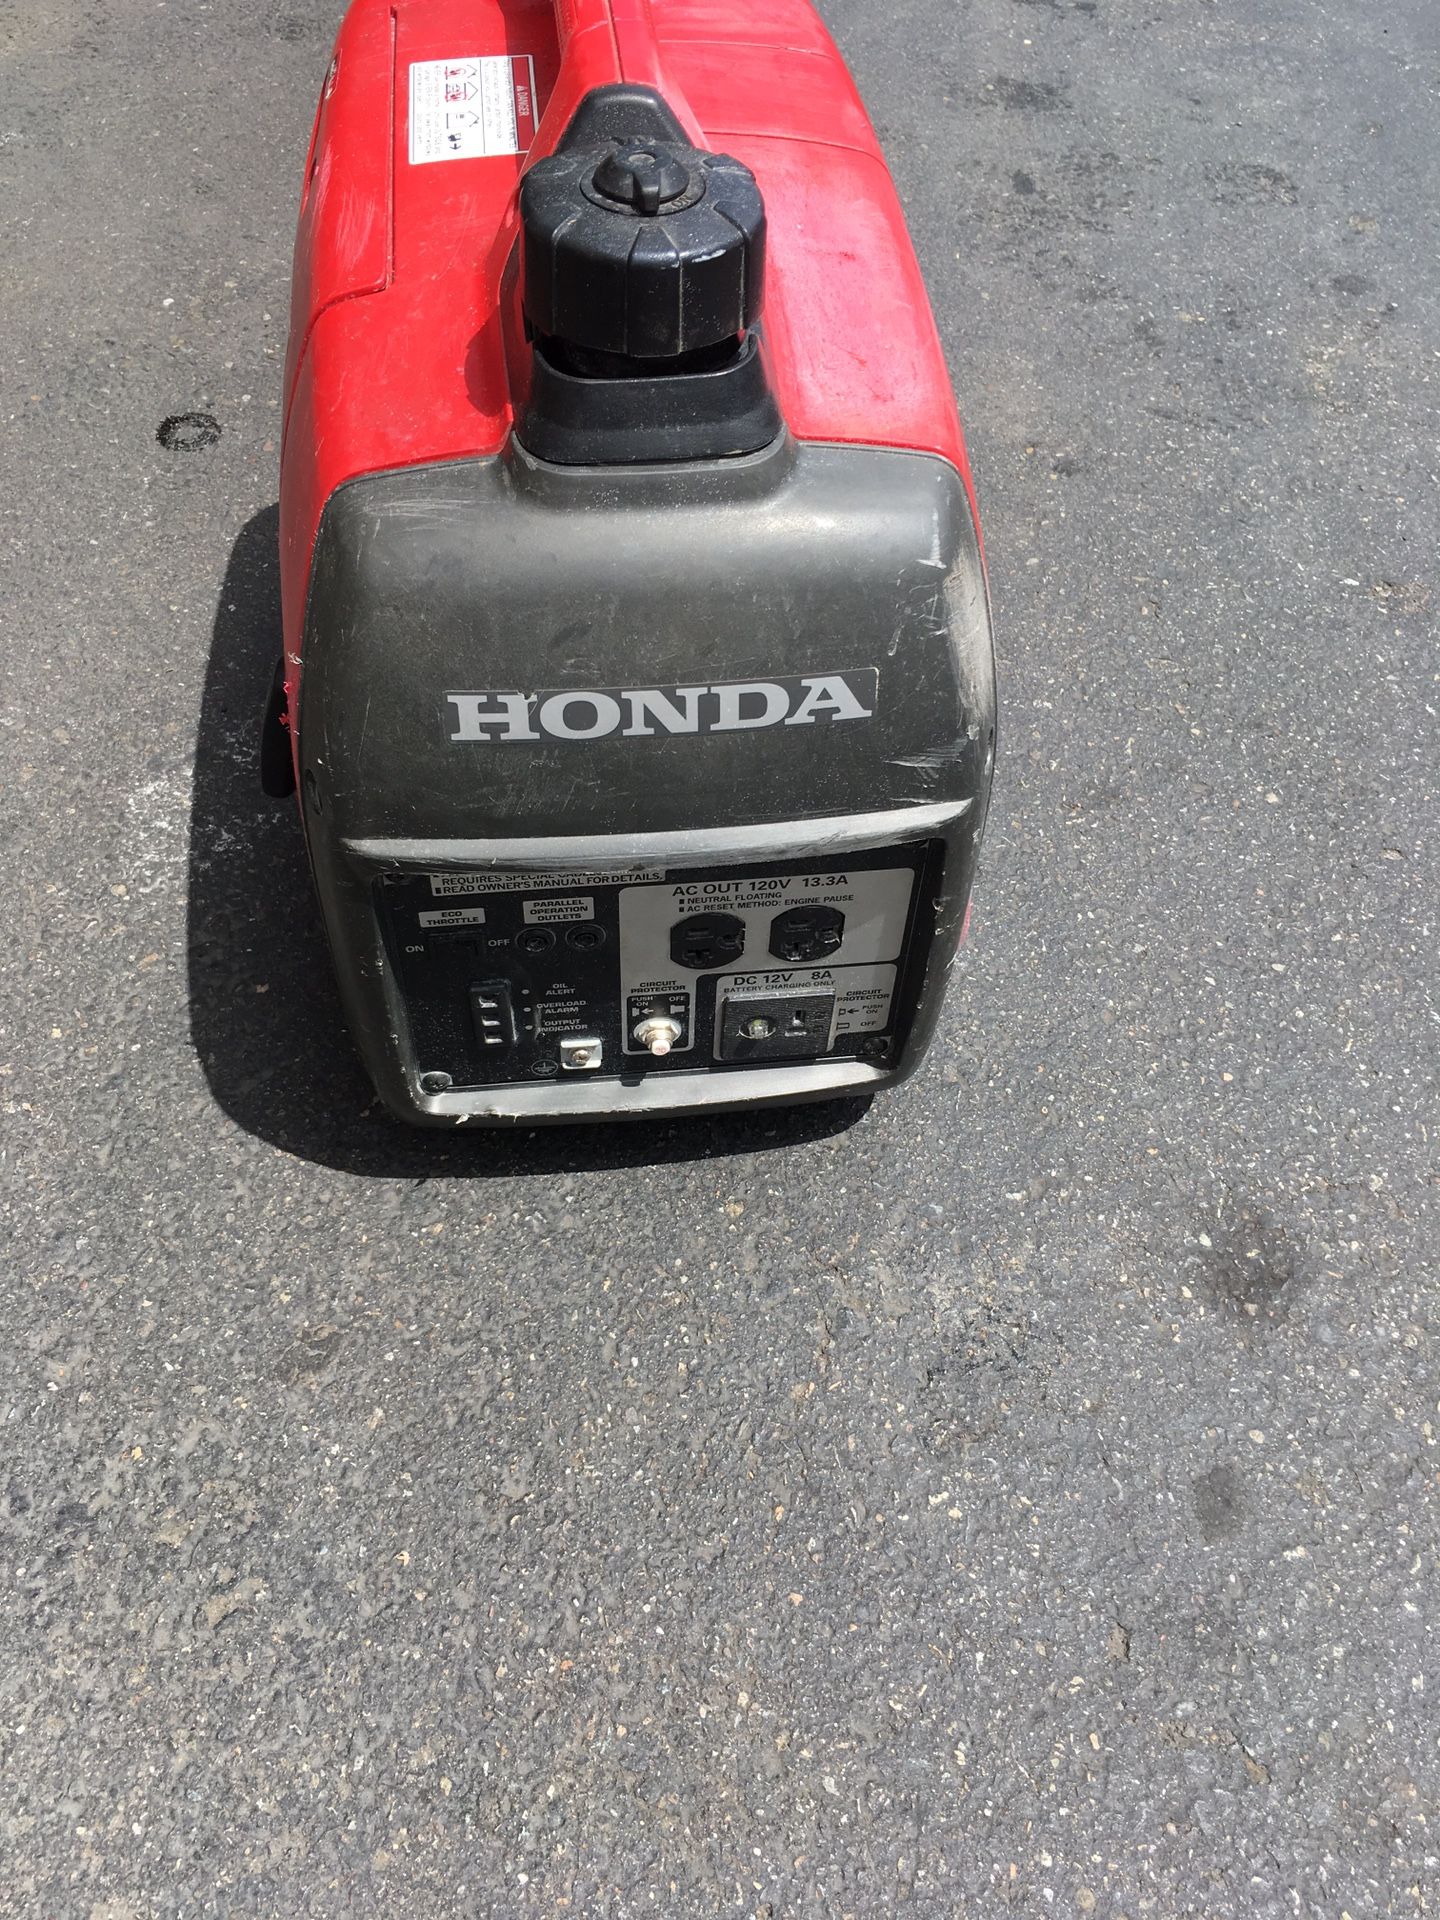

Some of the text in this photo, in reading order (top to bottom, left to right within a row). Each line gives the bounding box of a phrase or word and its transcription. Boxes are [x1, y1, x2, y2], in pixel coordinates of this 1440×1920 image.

[517, 92, 529, 117] DANGER
[447, 676, 872, 740] HONDA
[442, 875, 502, 886] REQUIRES
[443, 886, 474, 894] READ
[477, 881, 531, 891] OWNER'S
[533, 878, 584, 888] MANUAL
[587, 875, 610, 885] FOR
[612, 872, 663, 883] DETAILS.
[672, 875, 848, 896] AC OUT 120V 13.3A
[687, 892, 782, 904] NEUTRAL FLOATING
[703, 903, 734, 911] RESET
[737, 900, 781, 909] METHOD:
[784, 897, 821, 905] ENGINE
[823, 894, 854, 902] PAUSE
[533, 899, 584, 908] PARALLEL
[441, 910, 462, 918] ECO
[529, 906, 588, 915] OPERATION
[426, 917, 479, 926] THROTTLE
[537, 913, 582, 922] OUTLETS
[488, 939, 511, 947] OFF
[405, 945, 424, 953] ON
[733, 970, 832, 986] DC 12V 8A
[639, 980, 677, 988] CIRCUIT
[723, 985, 762, 993] BATTERY
[765, 982, 811, 991] CHARGING
[545, 988, 576, 996] ALERT
[630, 985, 686, 994] PROTECTOR
[846, 989, 883, 997] CIRCUIT
[836, 993, 890, 1002] PROTECTOR
[536, 1000, 587, 1009] OVERLOAD
[545, 1006, 579, 1014] ALARM
[544, 1018, 581, 1027] OUTPUT
